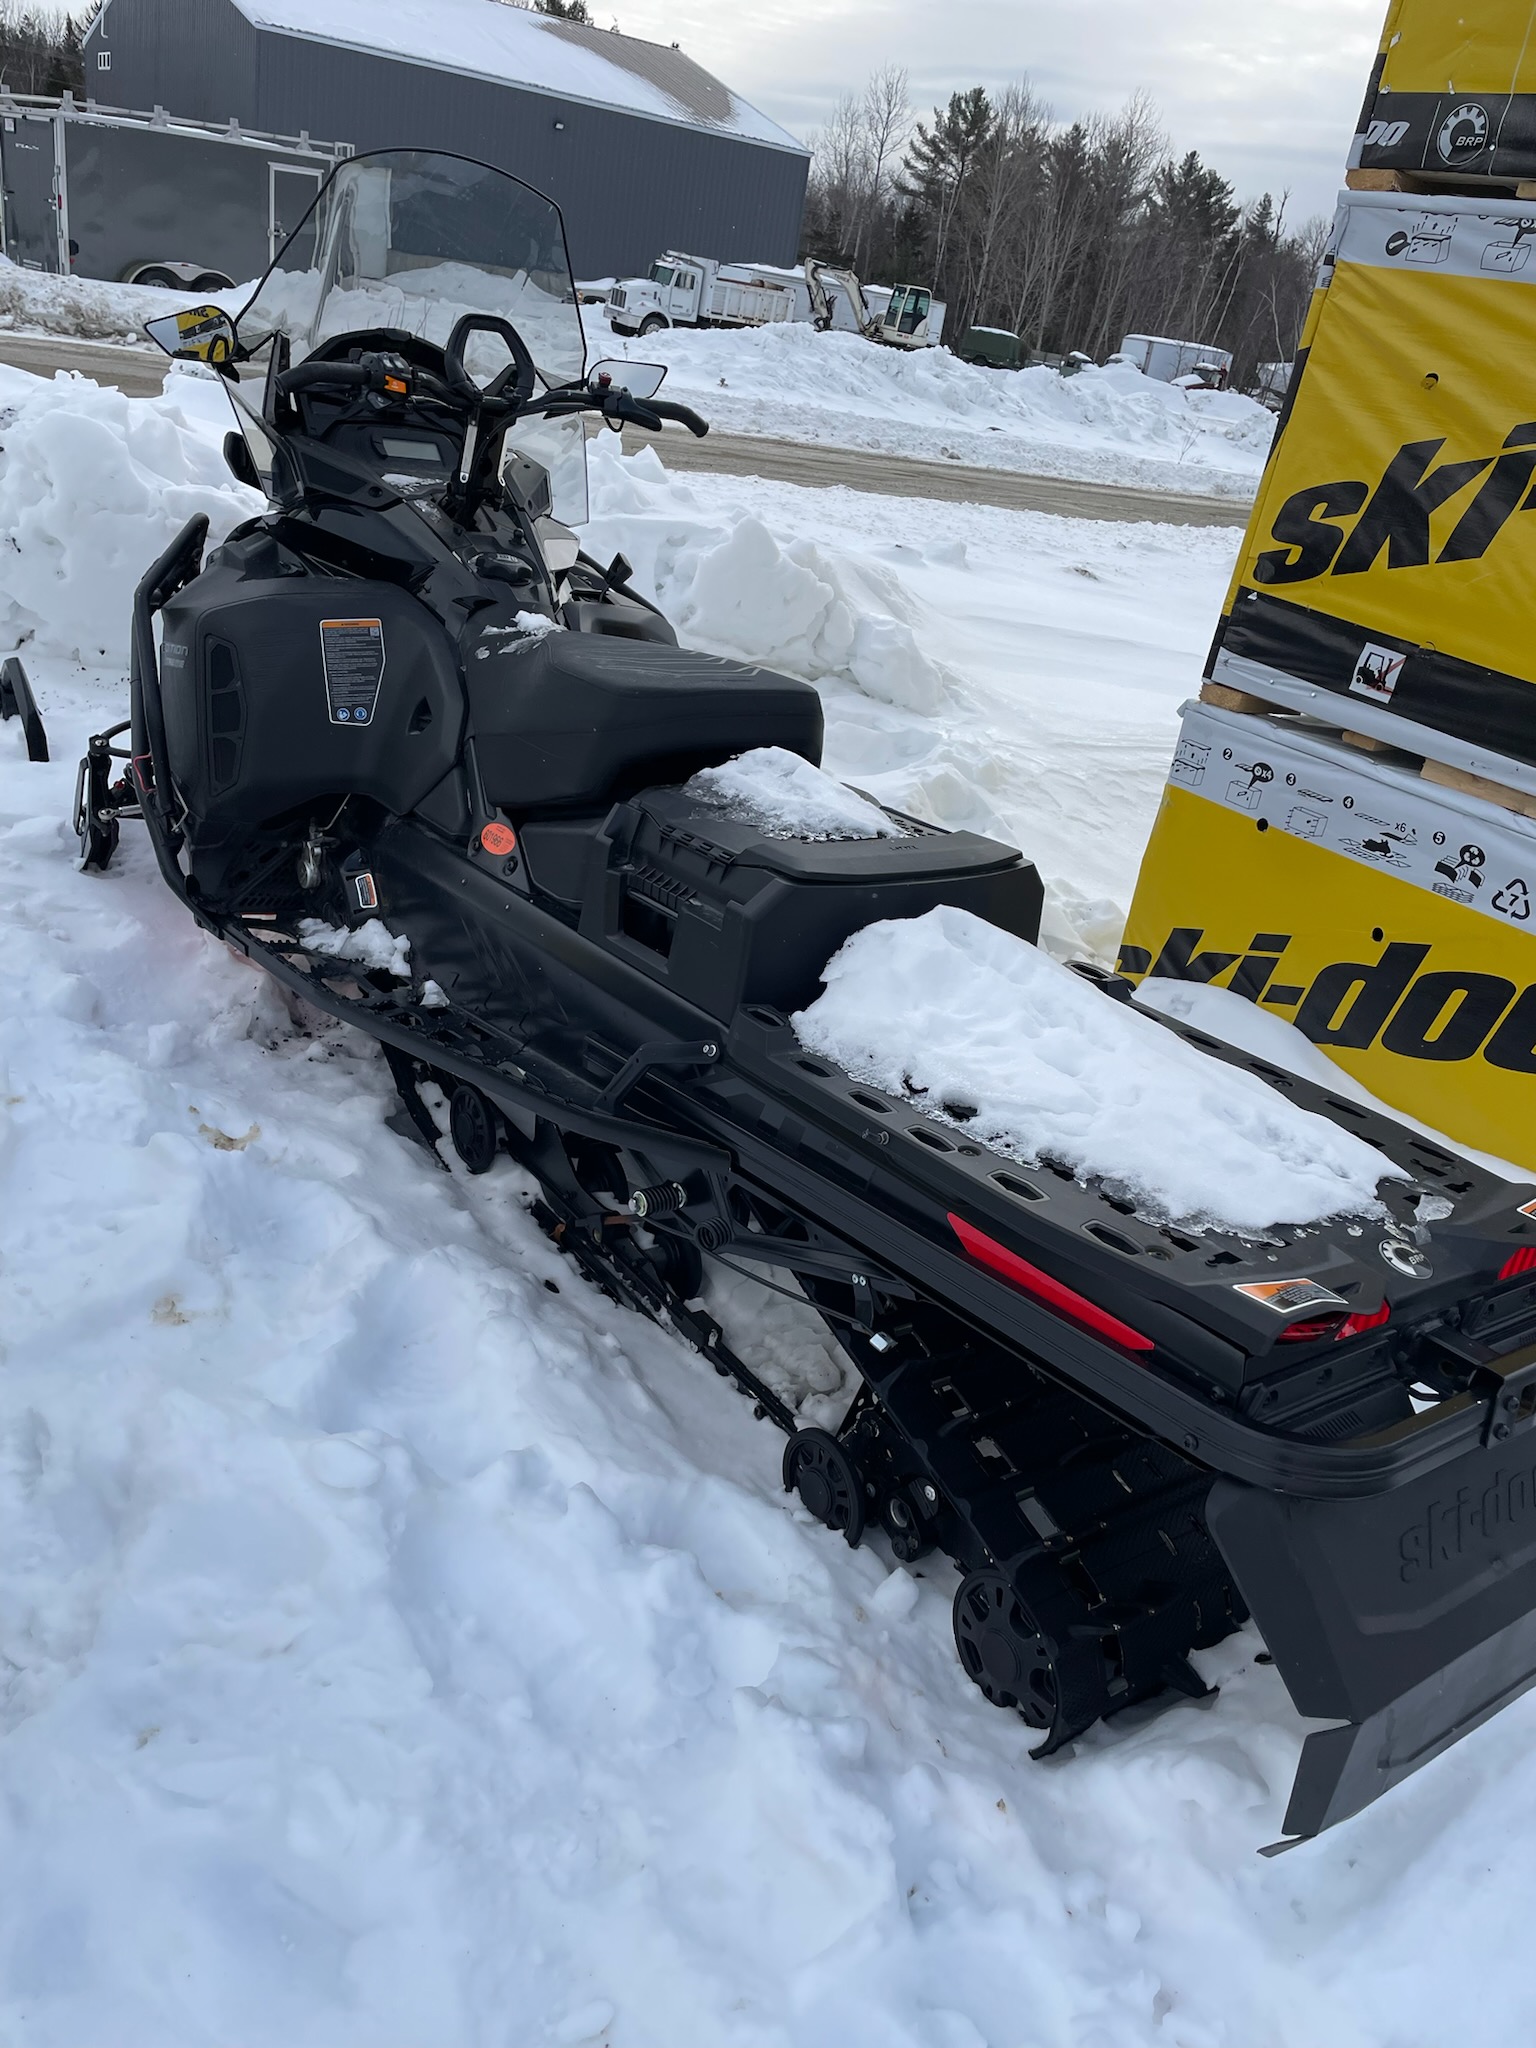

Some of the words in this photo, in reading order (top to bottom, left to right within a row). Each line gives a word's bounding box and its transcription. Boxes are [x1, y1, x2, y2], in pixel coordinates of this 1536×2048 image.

[1455, 136, 1484, 146] BRP
[1394, 822, 1406, 833] x6
[1508, 893, 1519, 906] 7
[1408, 1254, 1424, 1265] BRP
